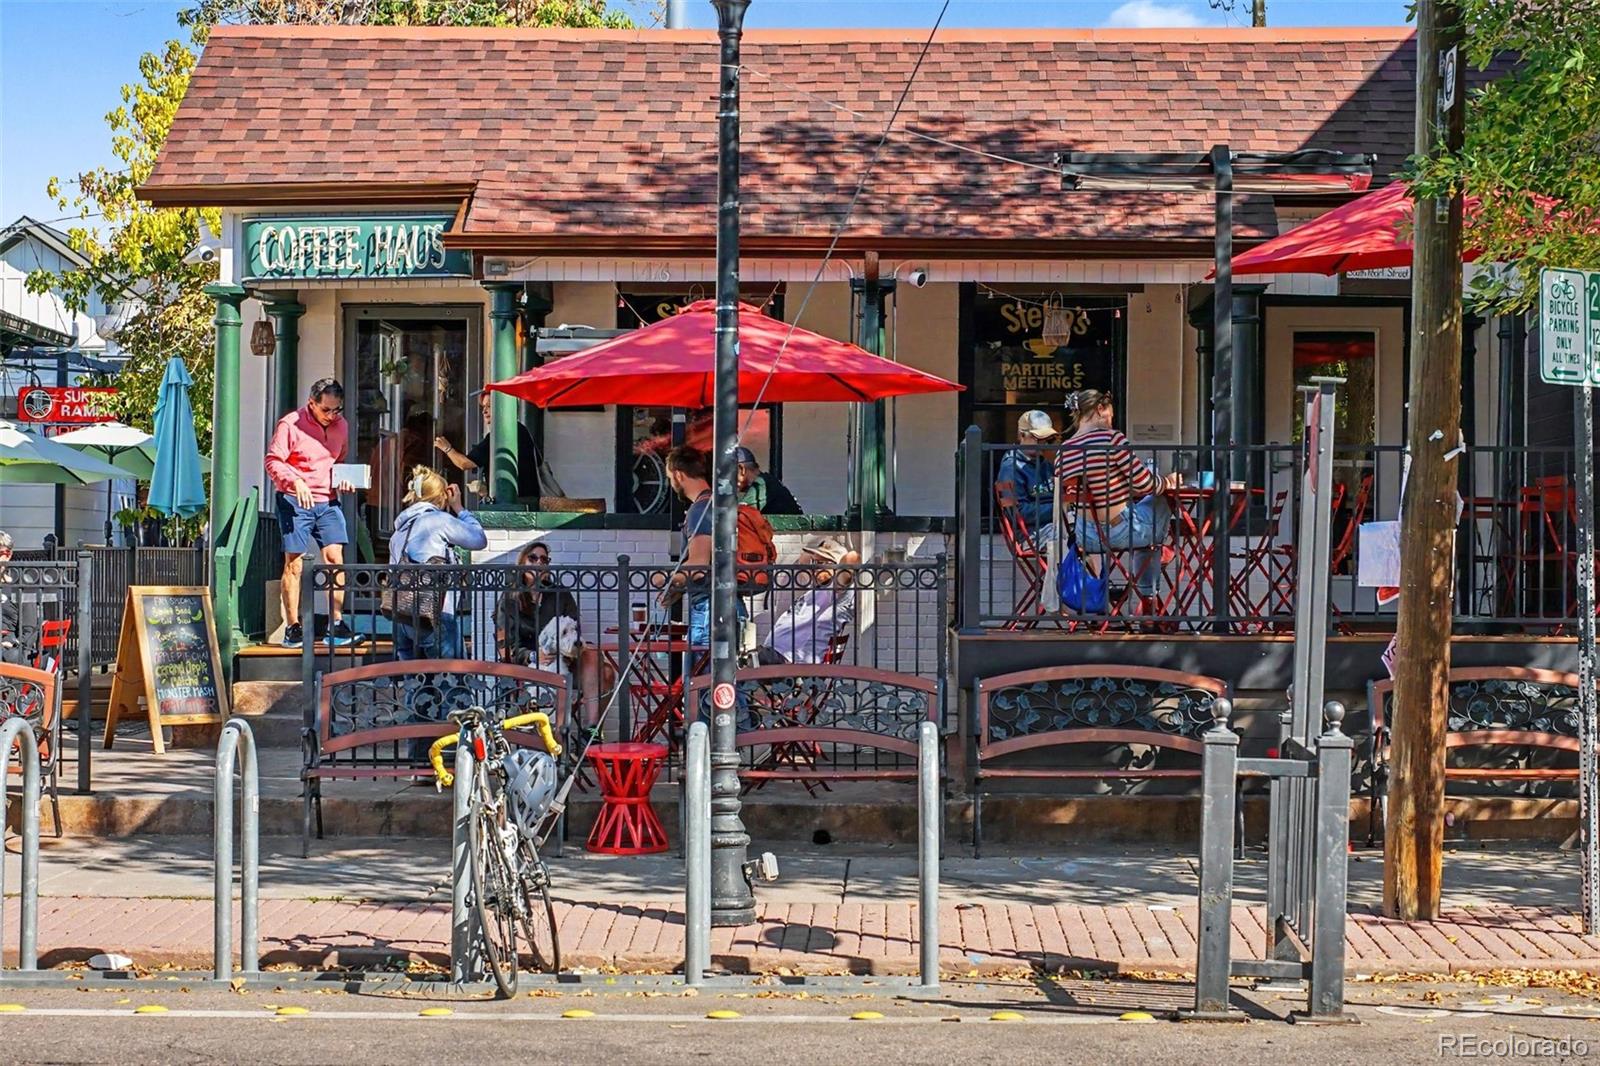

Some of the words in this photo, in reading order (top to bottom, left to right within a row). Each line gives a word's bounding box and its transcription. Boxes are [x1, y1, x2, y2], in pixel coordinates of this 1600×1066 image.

[259, 225, 362, 272] COFFEE
[374, 224, 446, 269] HAUS
[1549, 300, 1579, 316] BICYCLE
[1549, 318, 1580, 334] PARKING
[1556, 336, 1572, 350] ONLY
[1552, 352, 1563, 363] ALL
[1564, 353, 1580, 365] TIMES
[1001, 363, 1065, 376] PARTIES
[1003, 376, 1083, 390] MEETINGS
[157, 686, 191, 700] MONSTER
[192, 686, 215, 697] MASH
